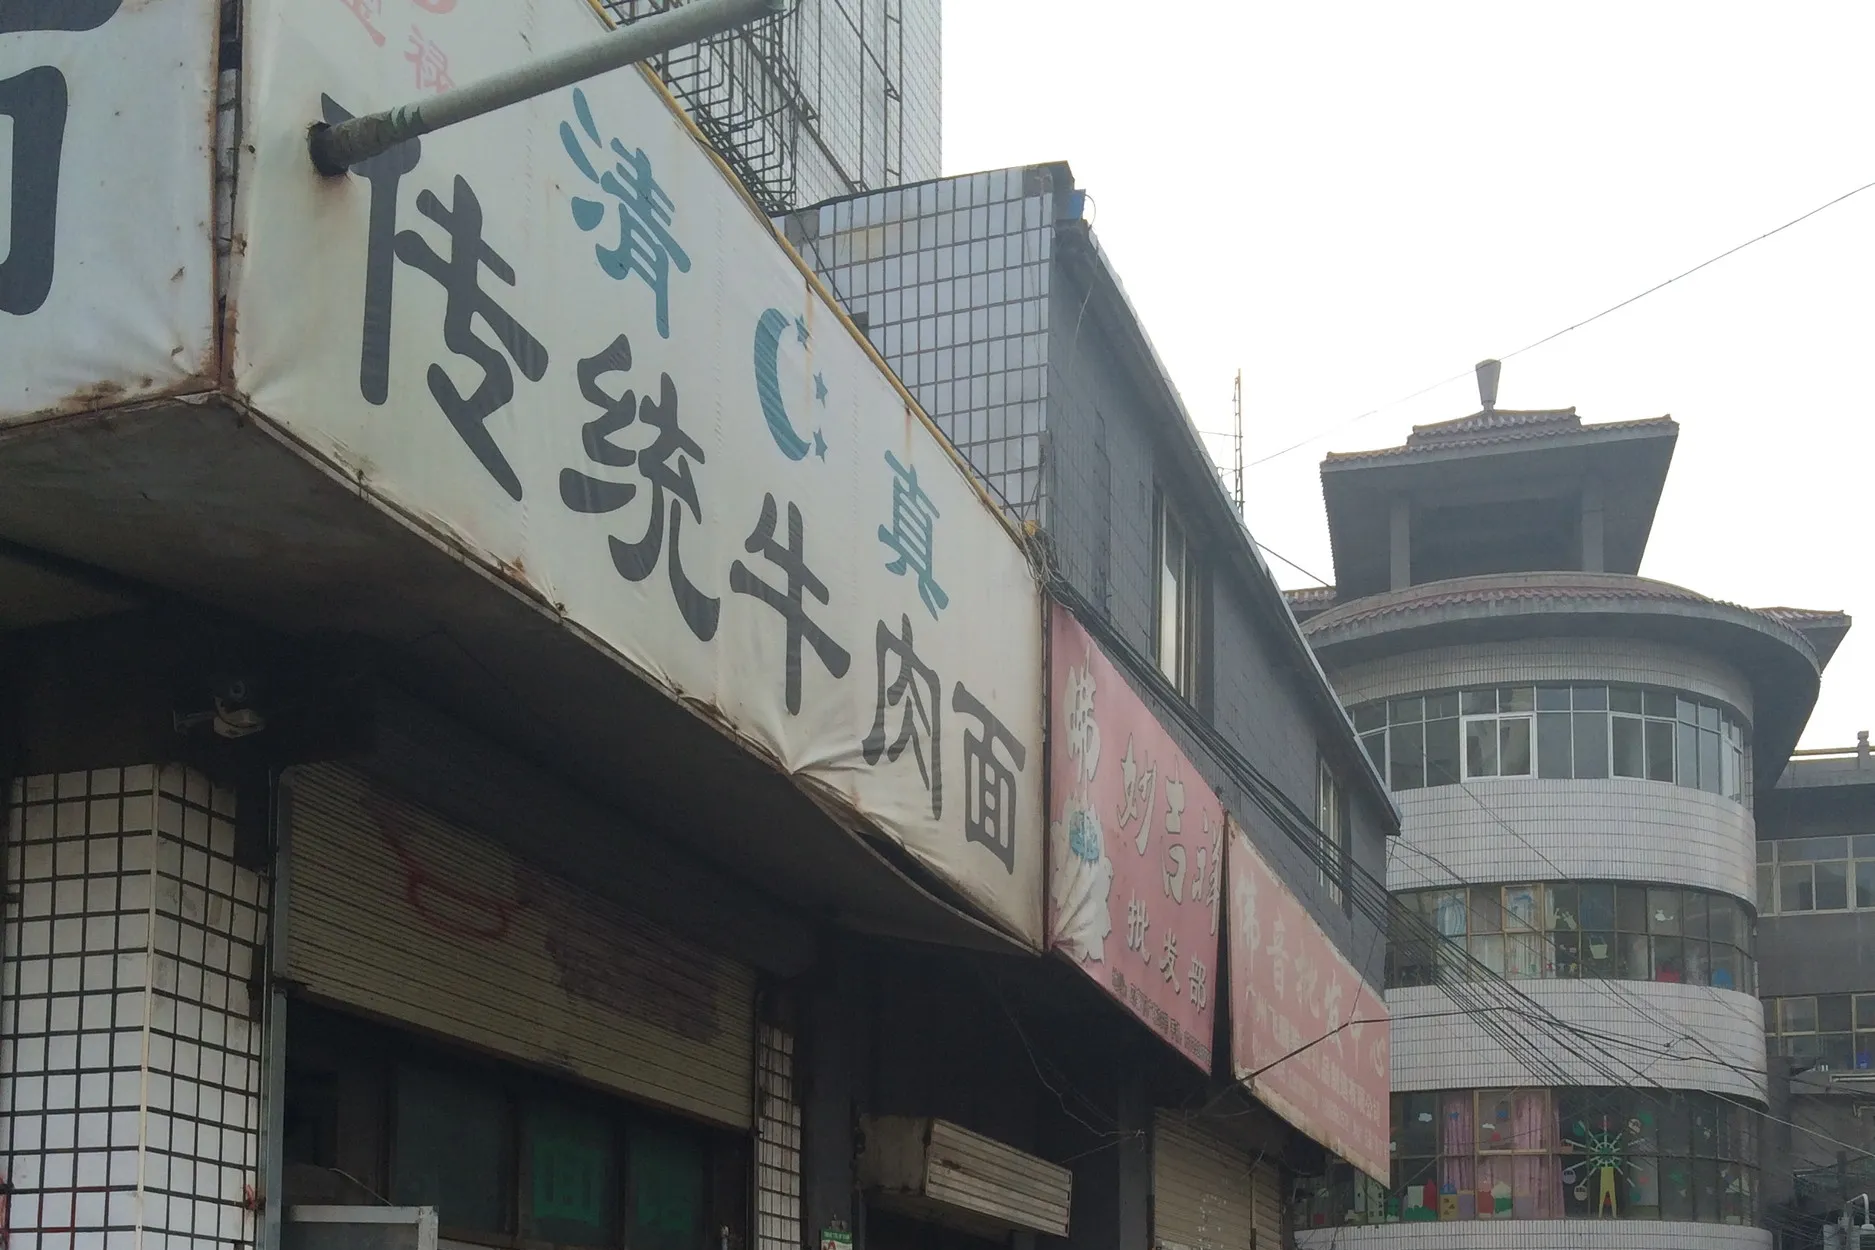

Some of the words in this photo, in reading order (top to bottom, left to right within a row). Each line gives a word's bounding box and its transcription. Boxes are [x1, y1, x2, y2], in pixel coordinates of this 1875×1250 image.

[320, 92, 1026, 875] 传统牛肉面
[1126, 889, 1209, 1014] 批发部
